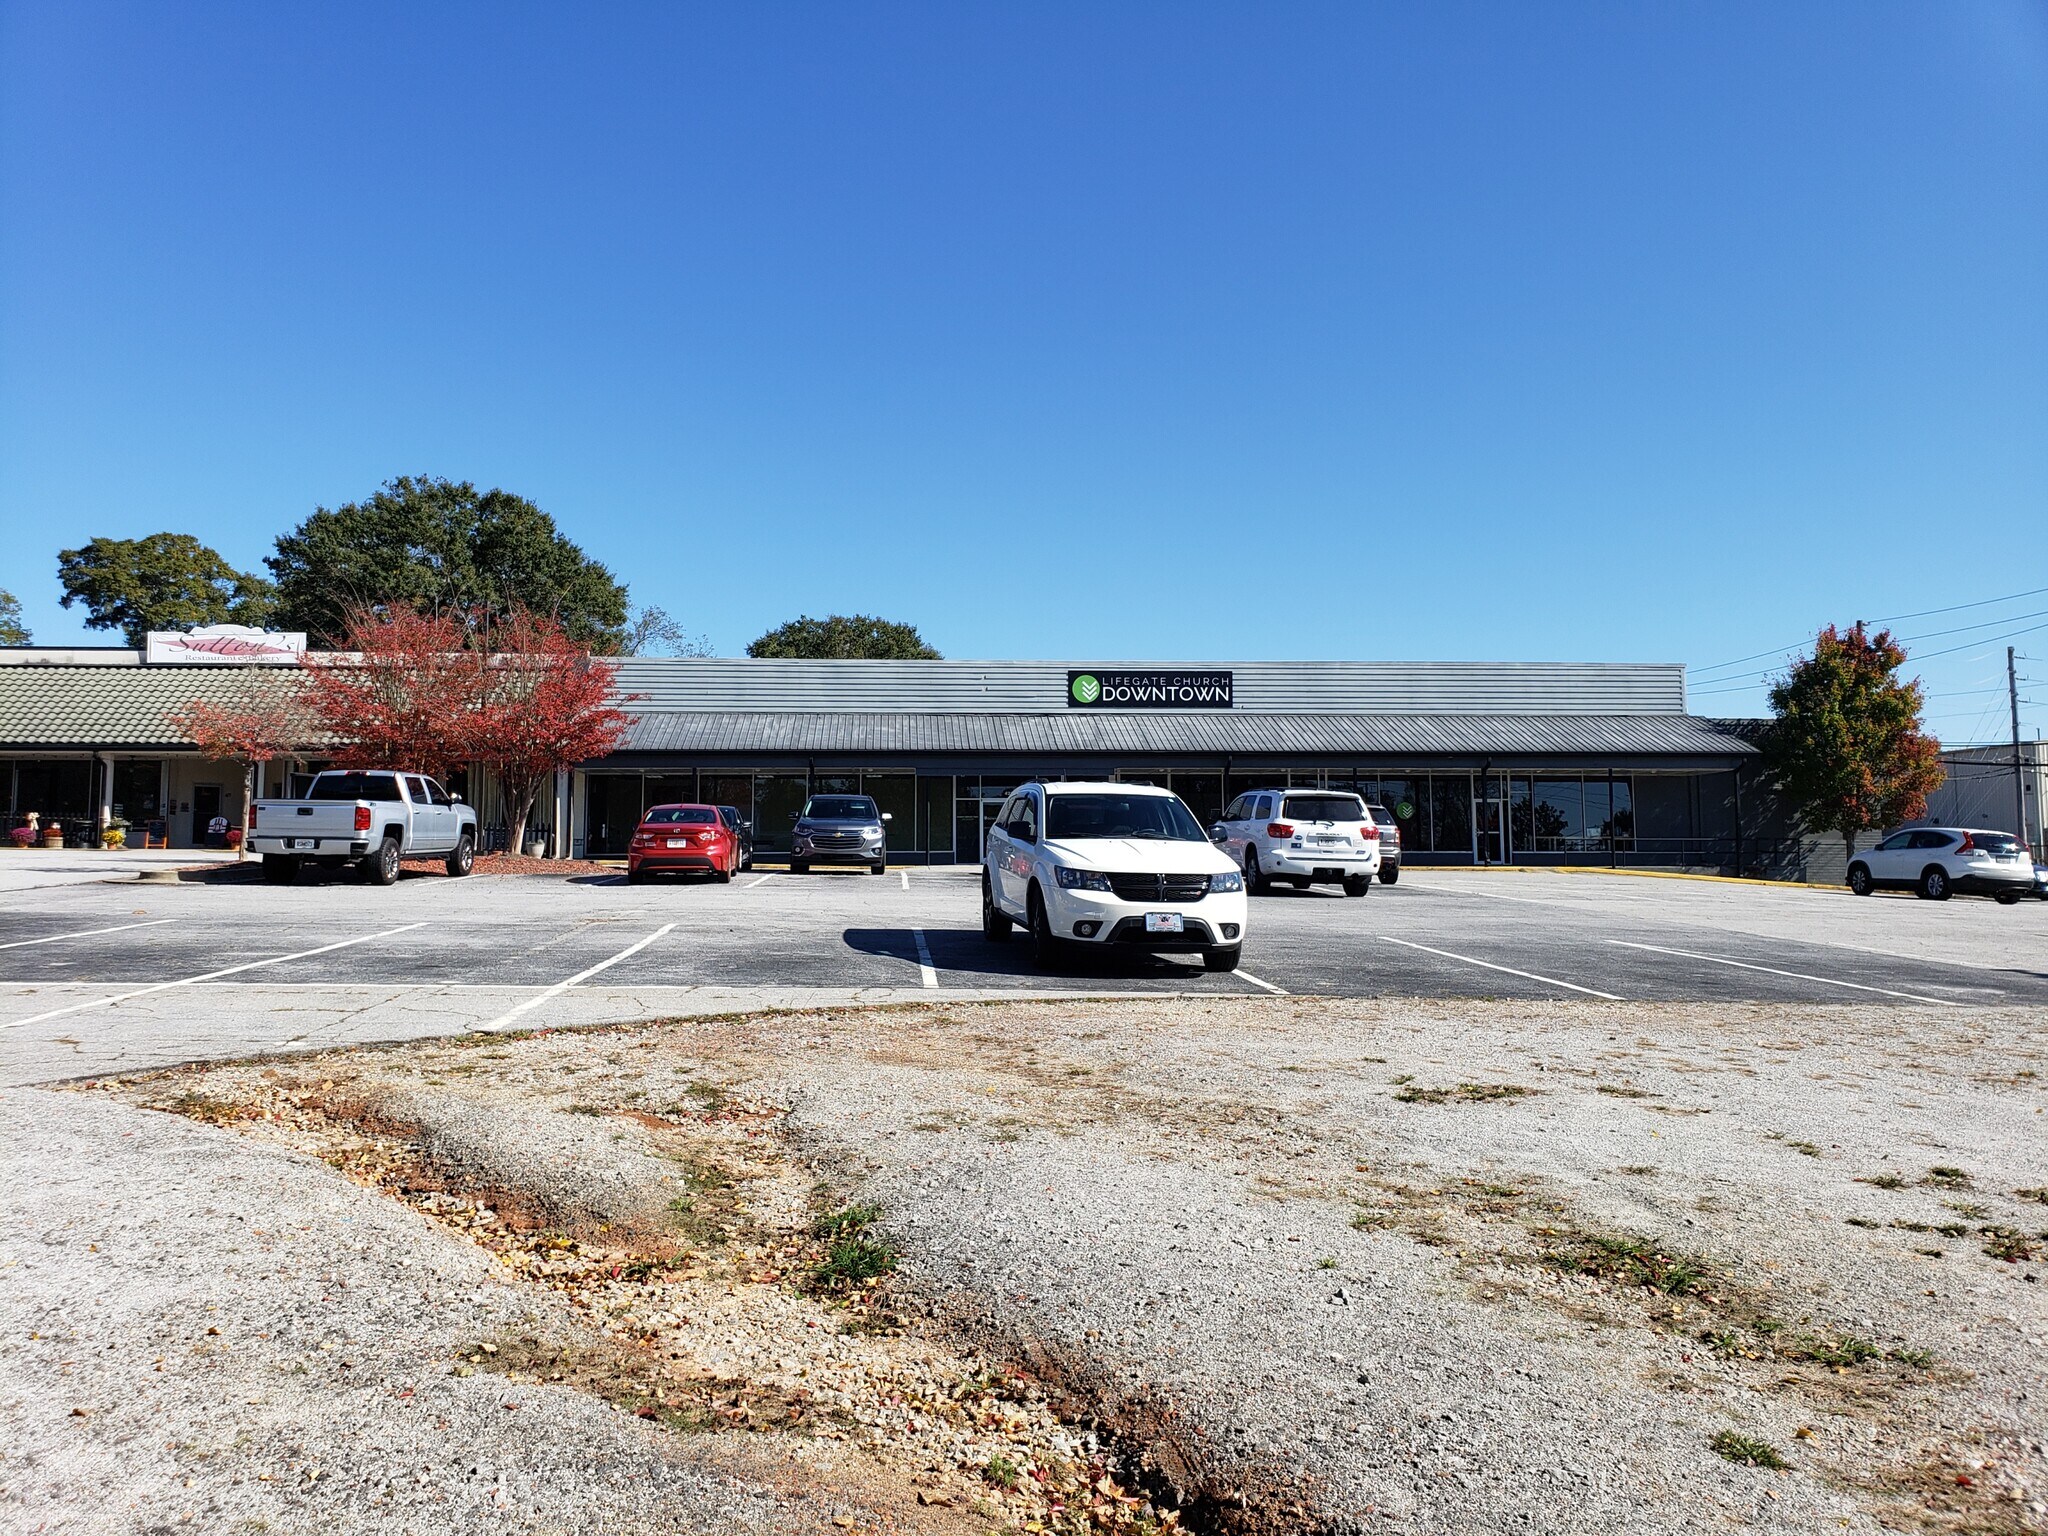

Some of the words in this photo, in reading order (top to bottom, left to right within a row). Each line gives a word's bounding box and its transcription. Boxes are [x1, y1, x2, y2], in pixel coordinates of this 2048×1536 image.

[169, 634, 296, 655] Sutton's
[1102, 677, 1167, 686] LIFEGATE
[1173, 677, 1229, 686] CHURCH
[1102, 686, 1229, 702] DOWNTOWN
